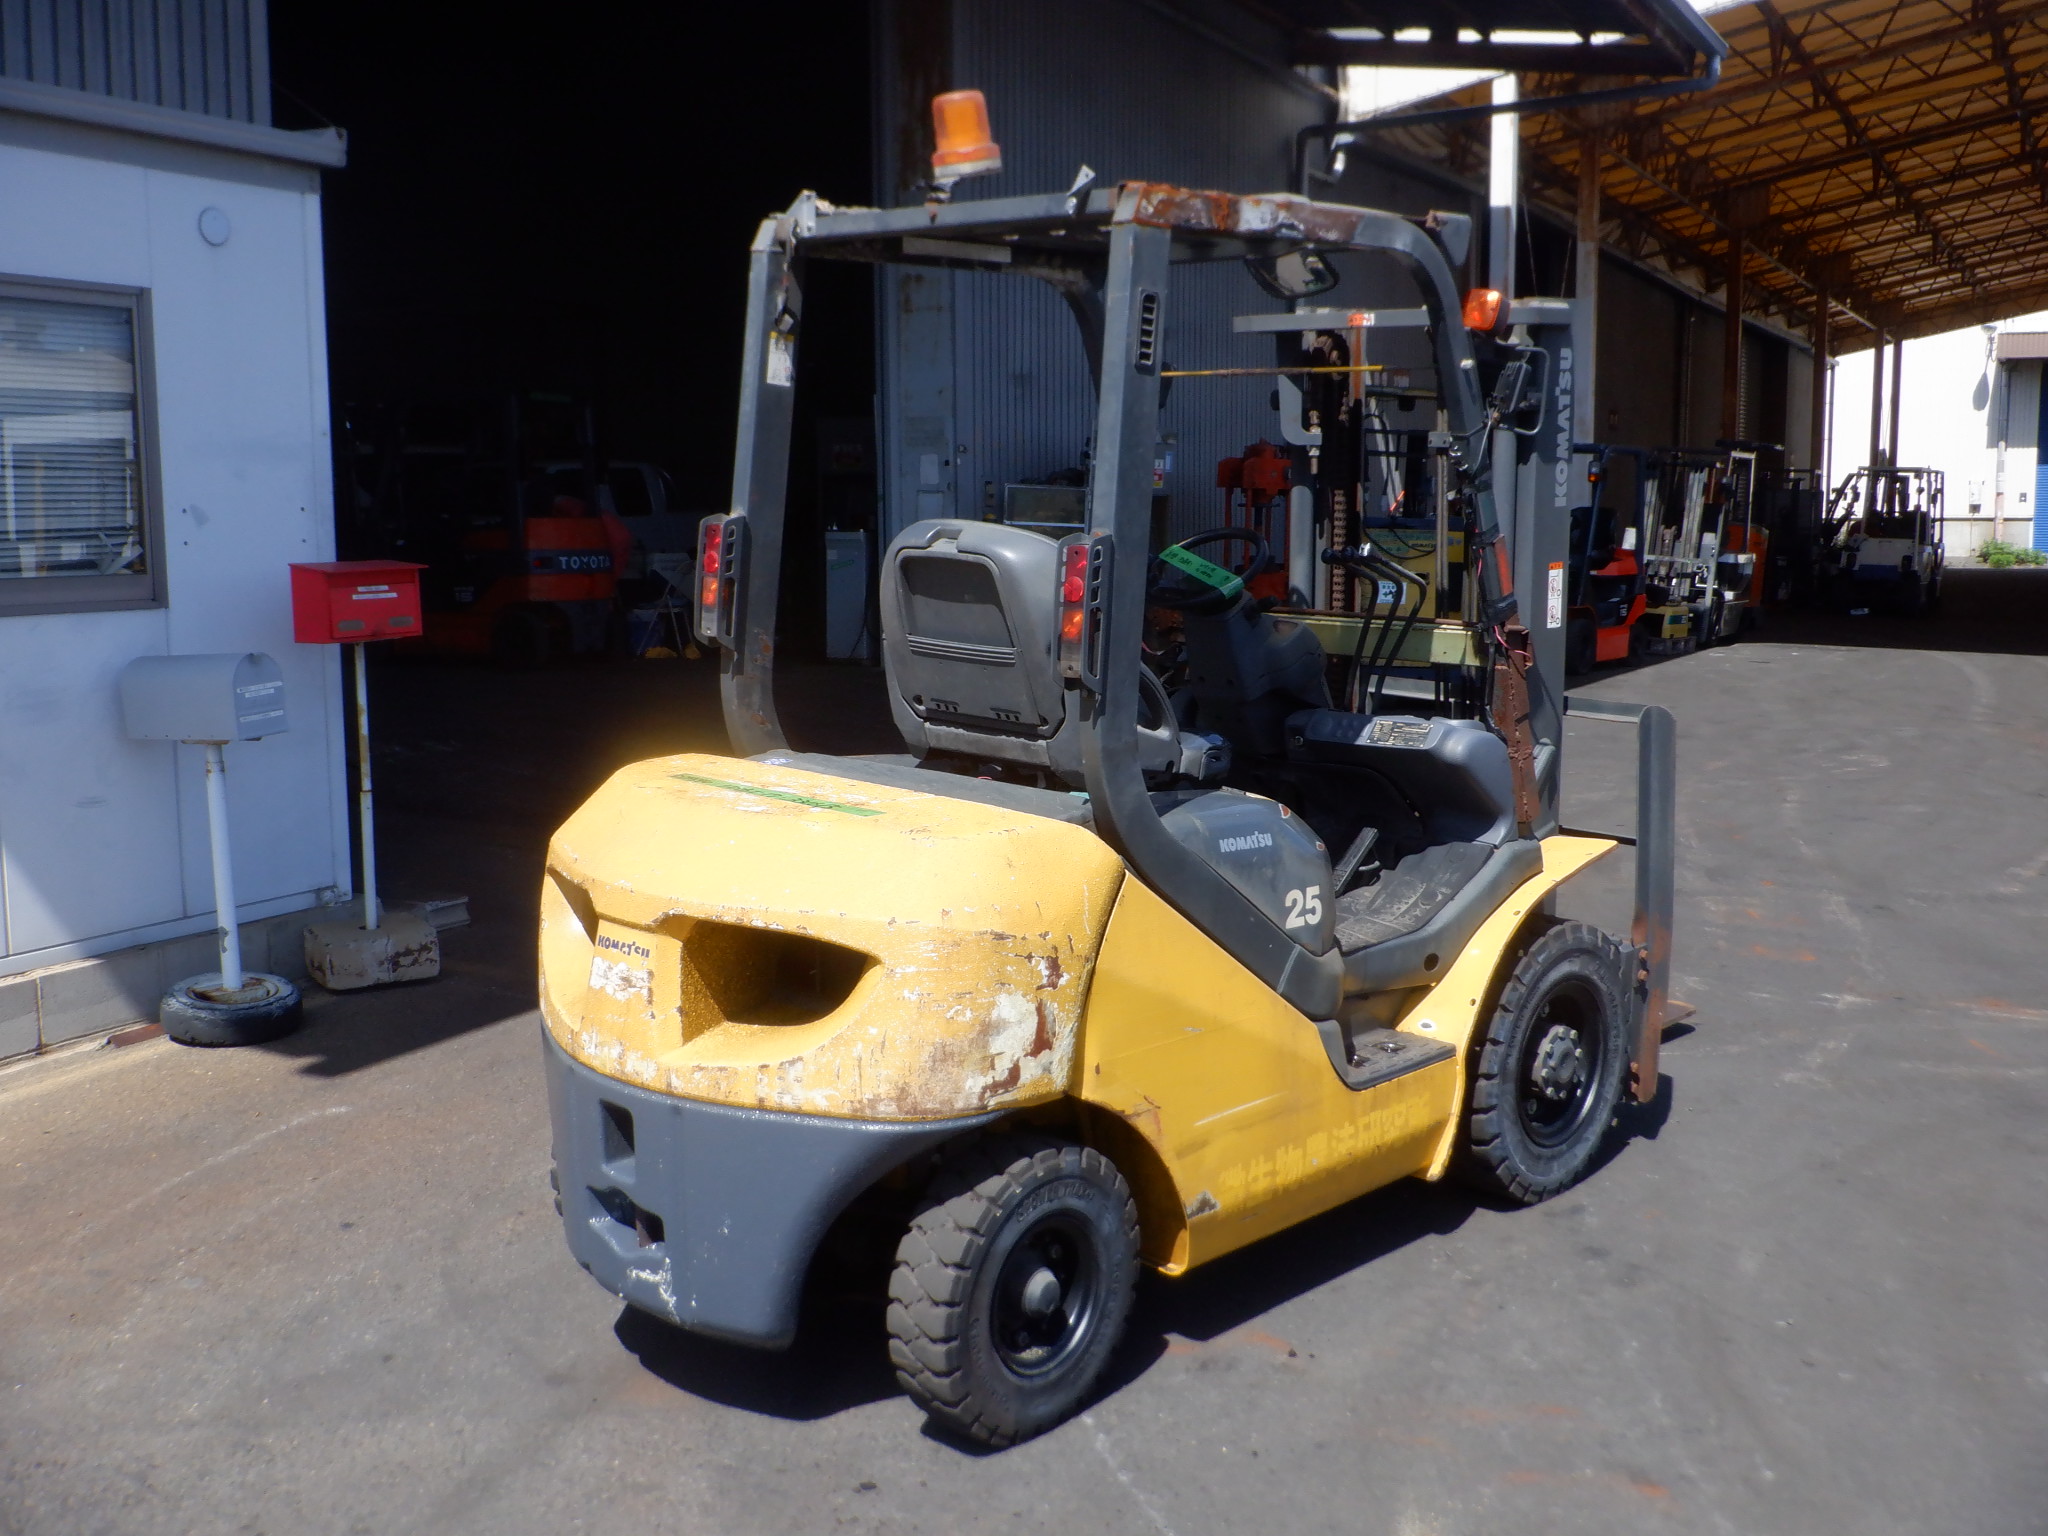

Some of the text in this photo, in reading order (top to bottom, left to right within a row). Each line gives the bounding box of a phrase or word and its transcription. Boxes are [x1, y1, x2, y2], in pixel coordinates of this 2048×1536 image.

[1554, 347, 1573, 508] KOMATSU
[558, 555, 611, 570] TOYOTA
[1219, 830, 1273, 853] KOMATSU
[1285, 885, 1322, 929] 25
